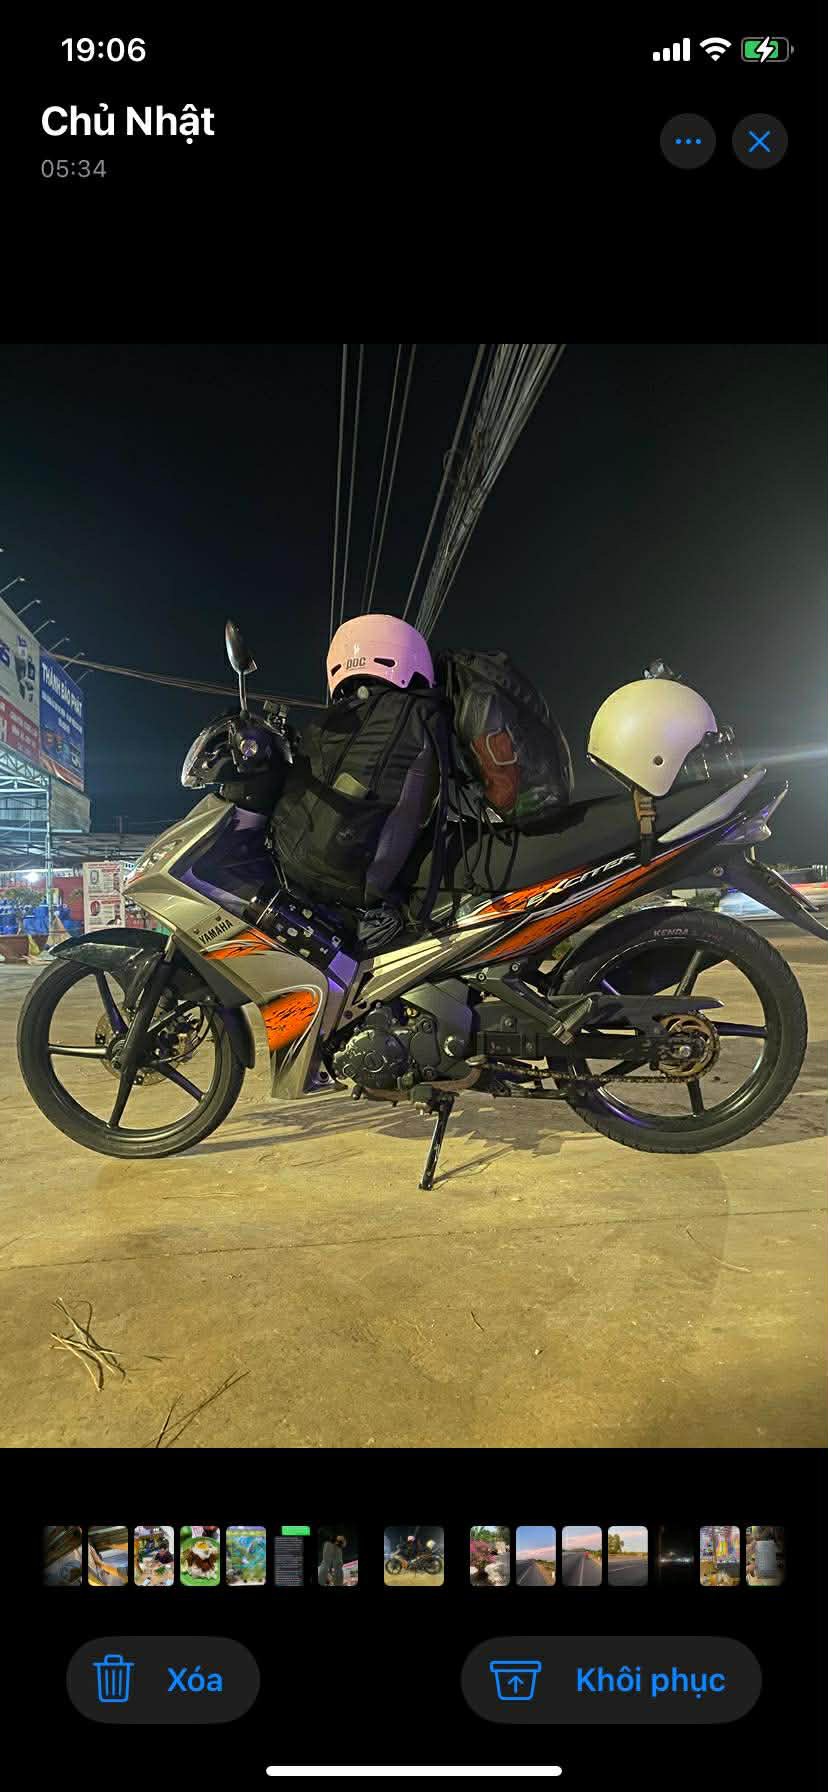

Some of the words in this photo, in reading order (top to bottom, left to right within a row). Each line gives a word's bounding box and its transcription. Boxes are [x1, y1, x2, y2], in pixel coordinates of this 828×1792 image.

[526, 852, 637, 908] EXCITER
[198, 919, 234, 945] YAMAHA
[653, 927, 689, 937] KENDA
